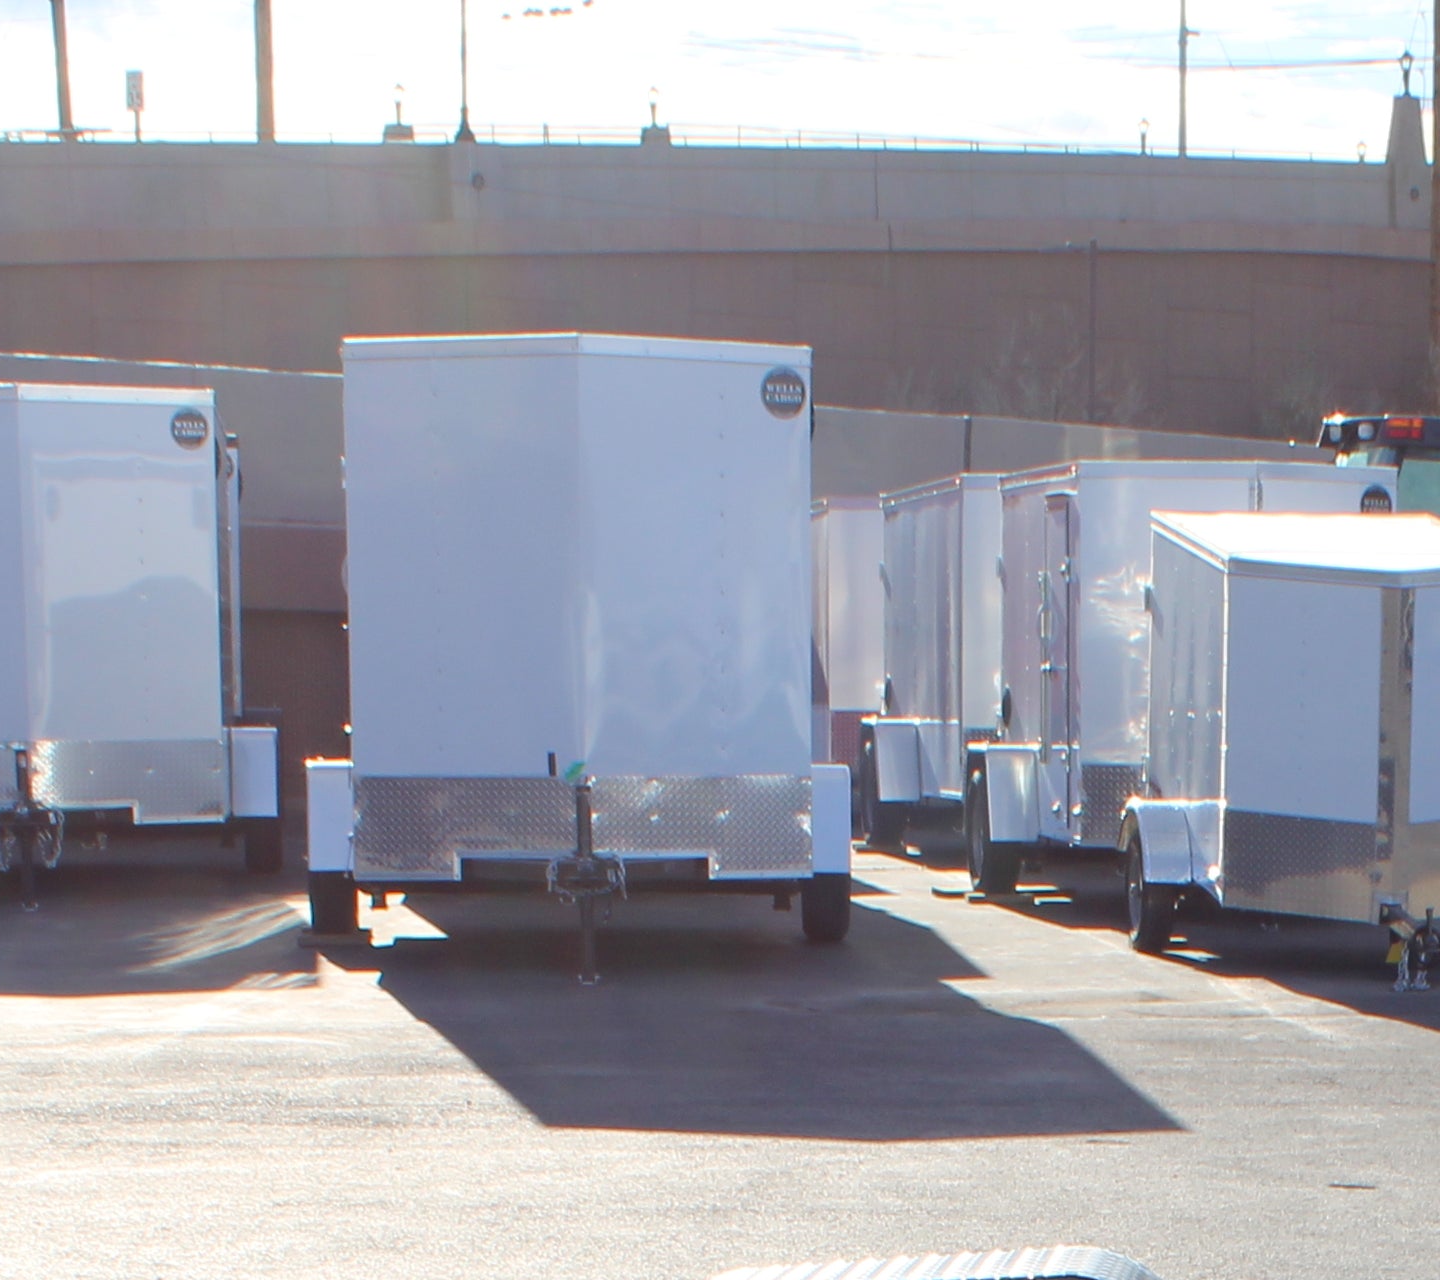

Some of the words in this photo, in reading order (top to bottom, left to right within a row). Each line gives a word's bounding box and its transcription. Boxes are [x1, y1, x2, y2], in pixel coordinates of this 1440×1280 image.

[765, 382, 803, 393] WELLS
[765, 393, 803, 403] CARGO
[174, 420, 206, 429] WELLS
